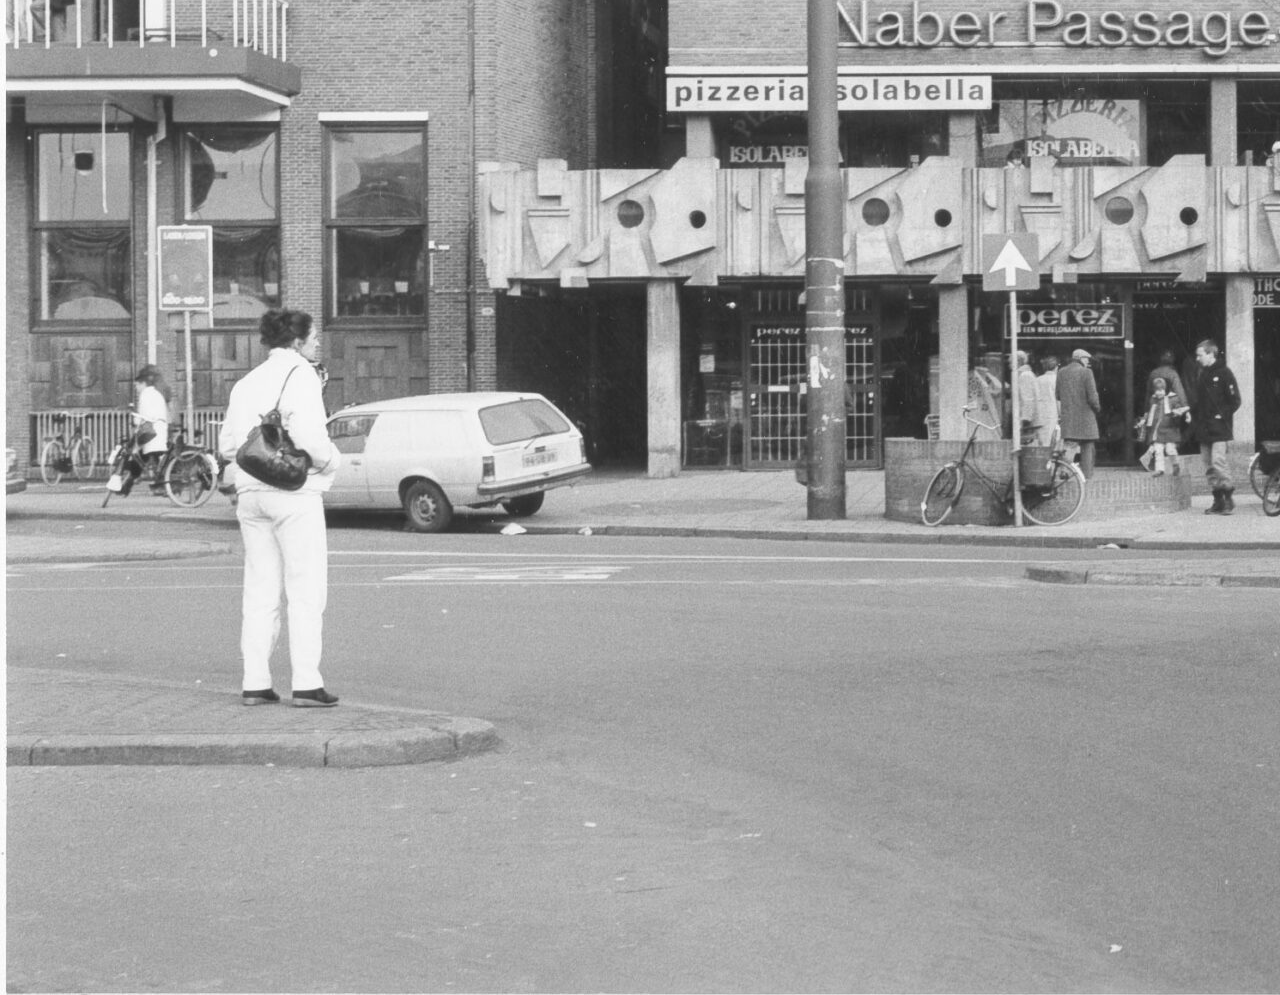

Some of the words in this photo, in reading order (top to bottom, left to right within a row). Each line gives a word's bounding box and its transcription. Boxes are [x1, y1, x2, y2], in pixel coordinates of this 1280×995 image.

[837, 0, 1006, 47] Naber
[1028, 0, 1270, 57] Passage
[674, 79, 805, 107] pizzeria
[836, 79, 985, 102] solabella
[729, 145, 844, 163] ISOLABE
[1251, 293, 1275, 305] ODE
[1016, 308, 1116, 333] perez
